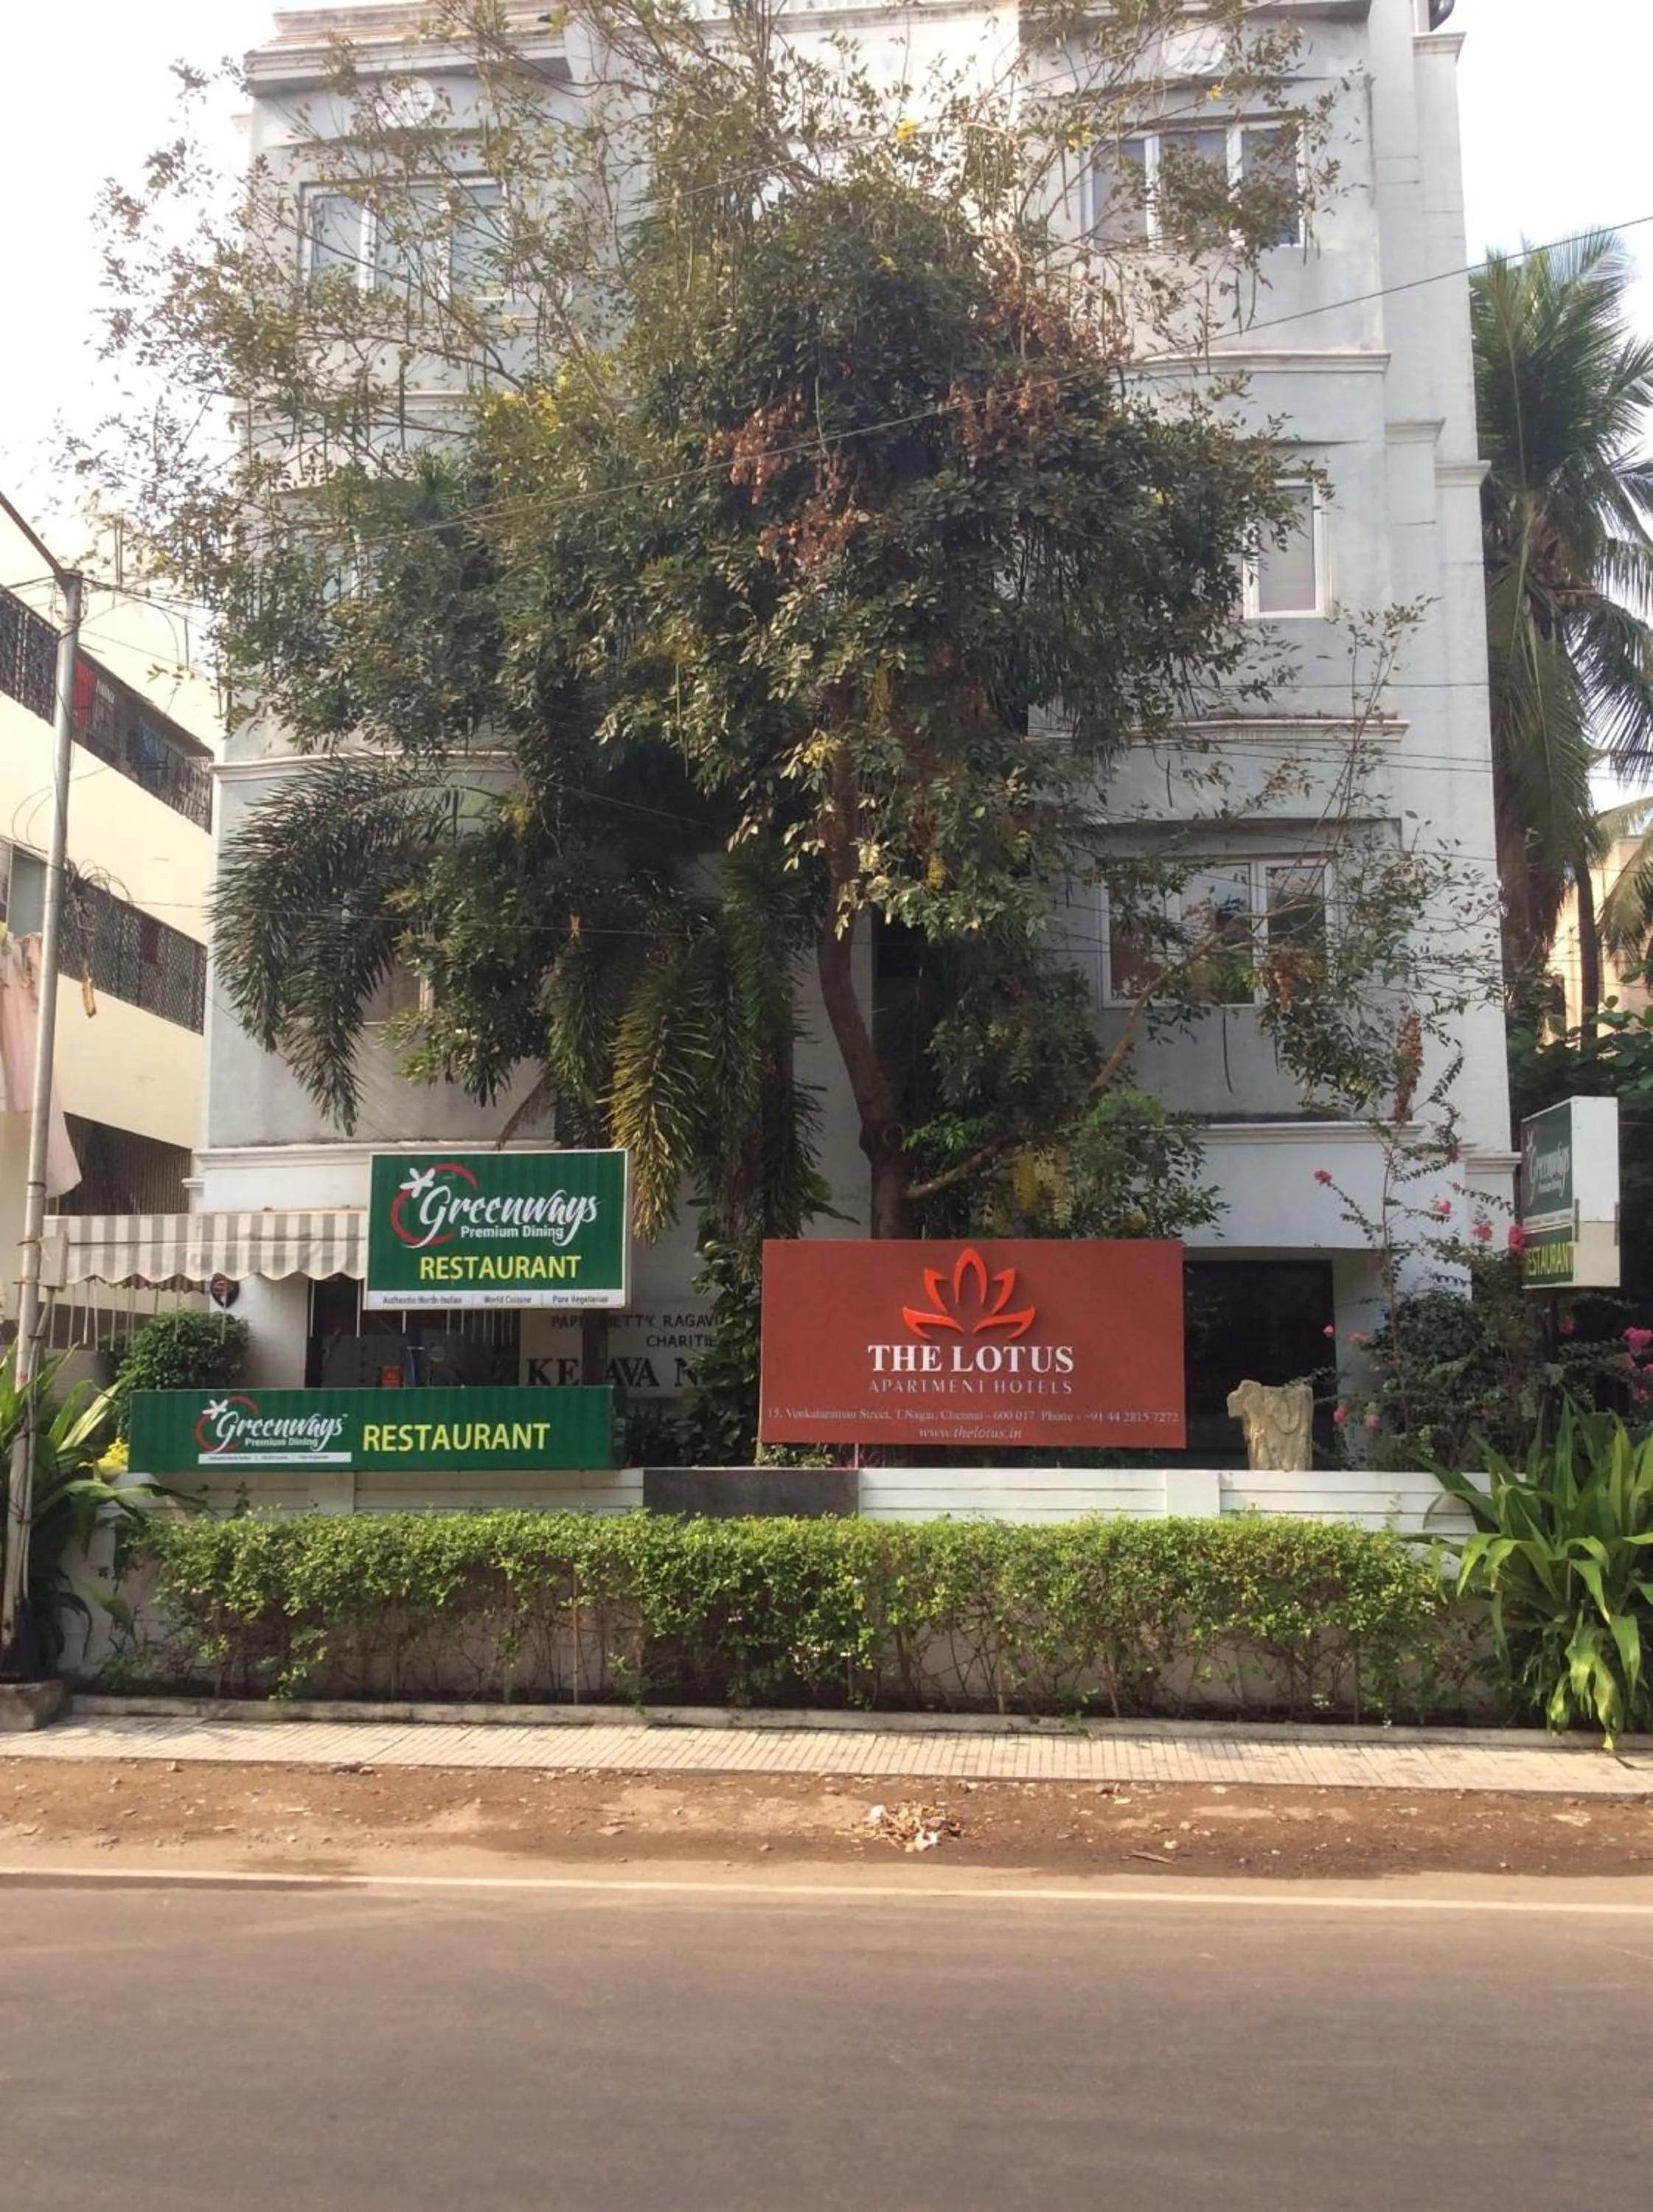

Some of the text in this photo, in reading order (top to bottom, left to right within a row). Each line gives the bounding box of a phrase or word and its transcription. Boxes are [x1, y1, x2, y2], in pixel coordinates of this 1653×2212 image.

[403, 1185, 598, 1248] Greenways
[460, 1225, 564, 1239] Premium Dining
[420, 1256, 581, 1280] RESTAURANT
[1524, 1241, 1573, 1276] ESTAURANT
[868, 1344, 1074, 1373] THE LOTUS
[869, 1379, 1073, 1394] APARTMENT HOTELS
[940, 1410, 983, 1420] Chennai
[993, 1411, 1013, 1421] 600
[1041, 1411, 1073, 1422] Phone
[212, 1411, 343, 1453] Greenways
[245, 1436, 318, 1447] Premium Dining
[363, 1423, 551, 1452] RESTAURANT
[919, 1426, 1022, 1440] www.thelotus.in
